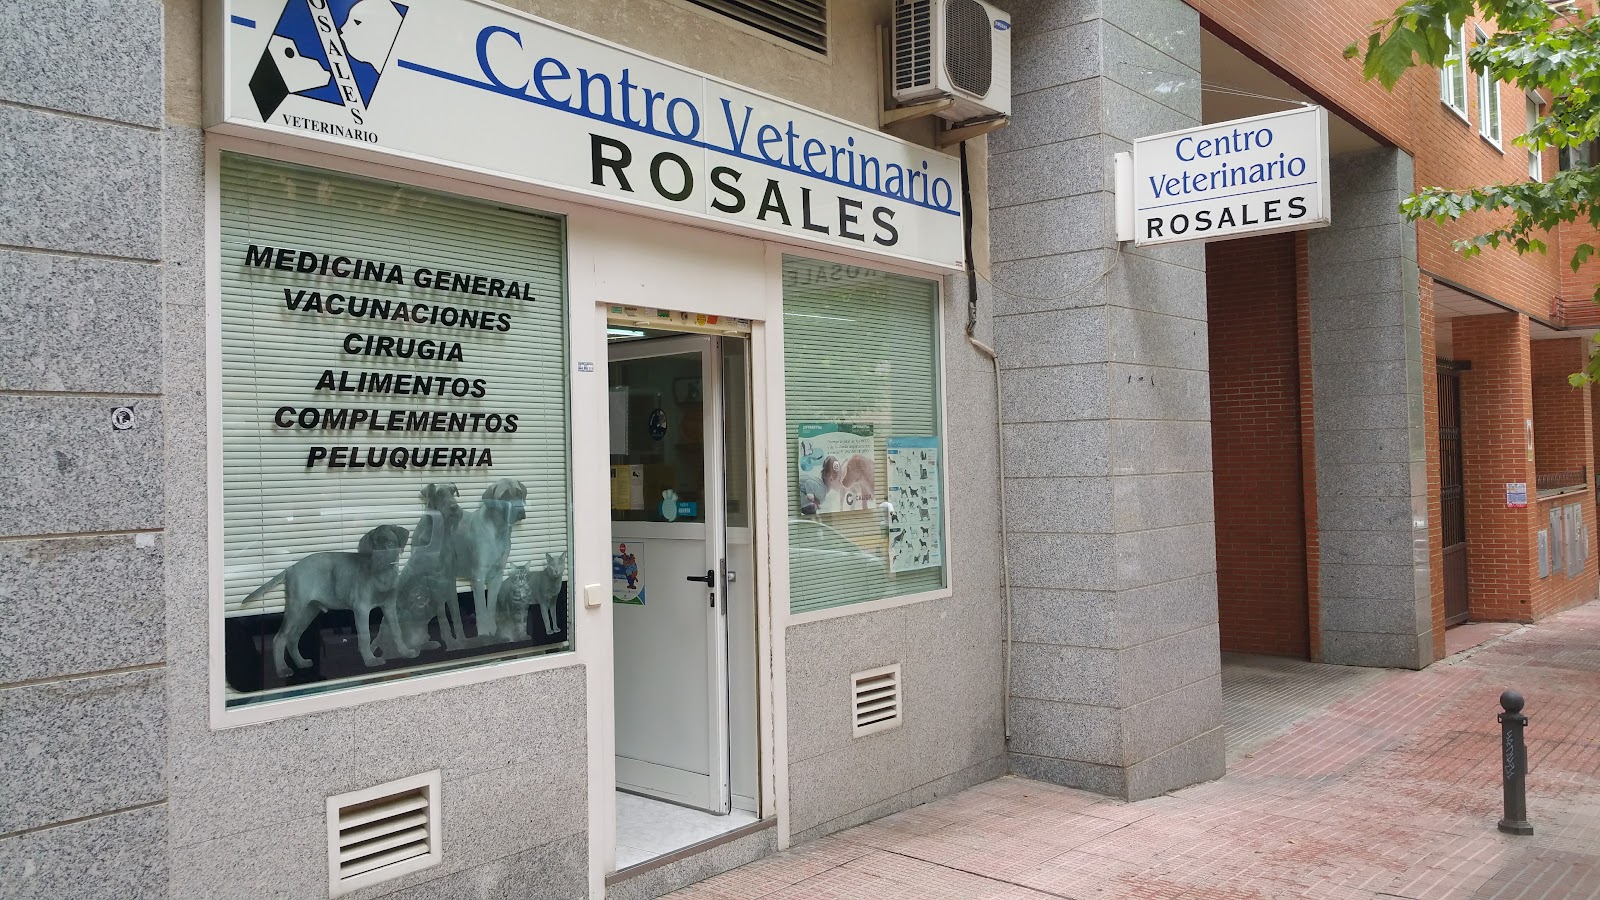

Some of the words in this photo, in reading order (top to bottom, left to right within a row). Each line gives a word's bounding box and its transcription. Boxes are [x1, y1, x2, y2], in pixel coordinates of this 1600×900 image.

[282, 113, 379, 145] VETERINARIO
[475, 25, 701, 141] Centro
[719, 97, 953, 209] Veterinario
[1175, 128, 1273, 162] Centro
[588, 132, 899, 247] ROSALES
[1148, 152, 1306, 199] Veterinario
[1147, 196, 1307, 239] ROSALES
[245, 244, 404, 285] MEDICINA
[413, 268, 536, 302] GENERAL
[283, 288, 512, 332] VACUNACIONES
[343, 333, 464, 363] CIRUGIA
[314, 369, 487, 398] ALIMENTOS
[274, 406, 519, 434] COMPLEMENTOS
[306, 446, 494, 469] PELUQUERIA
